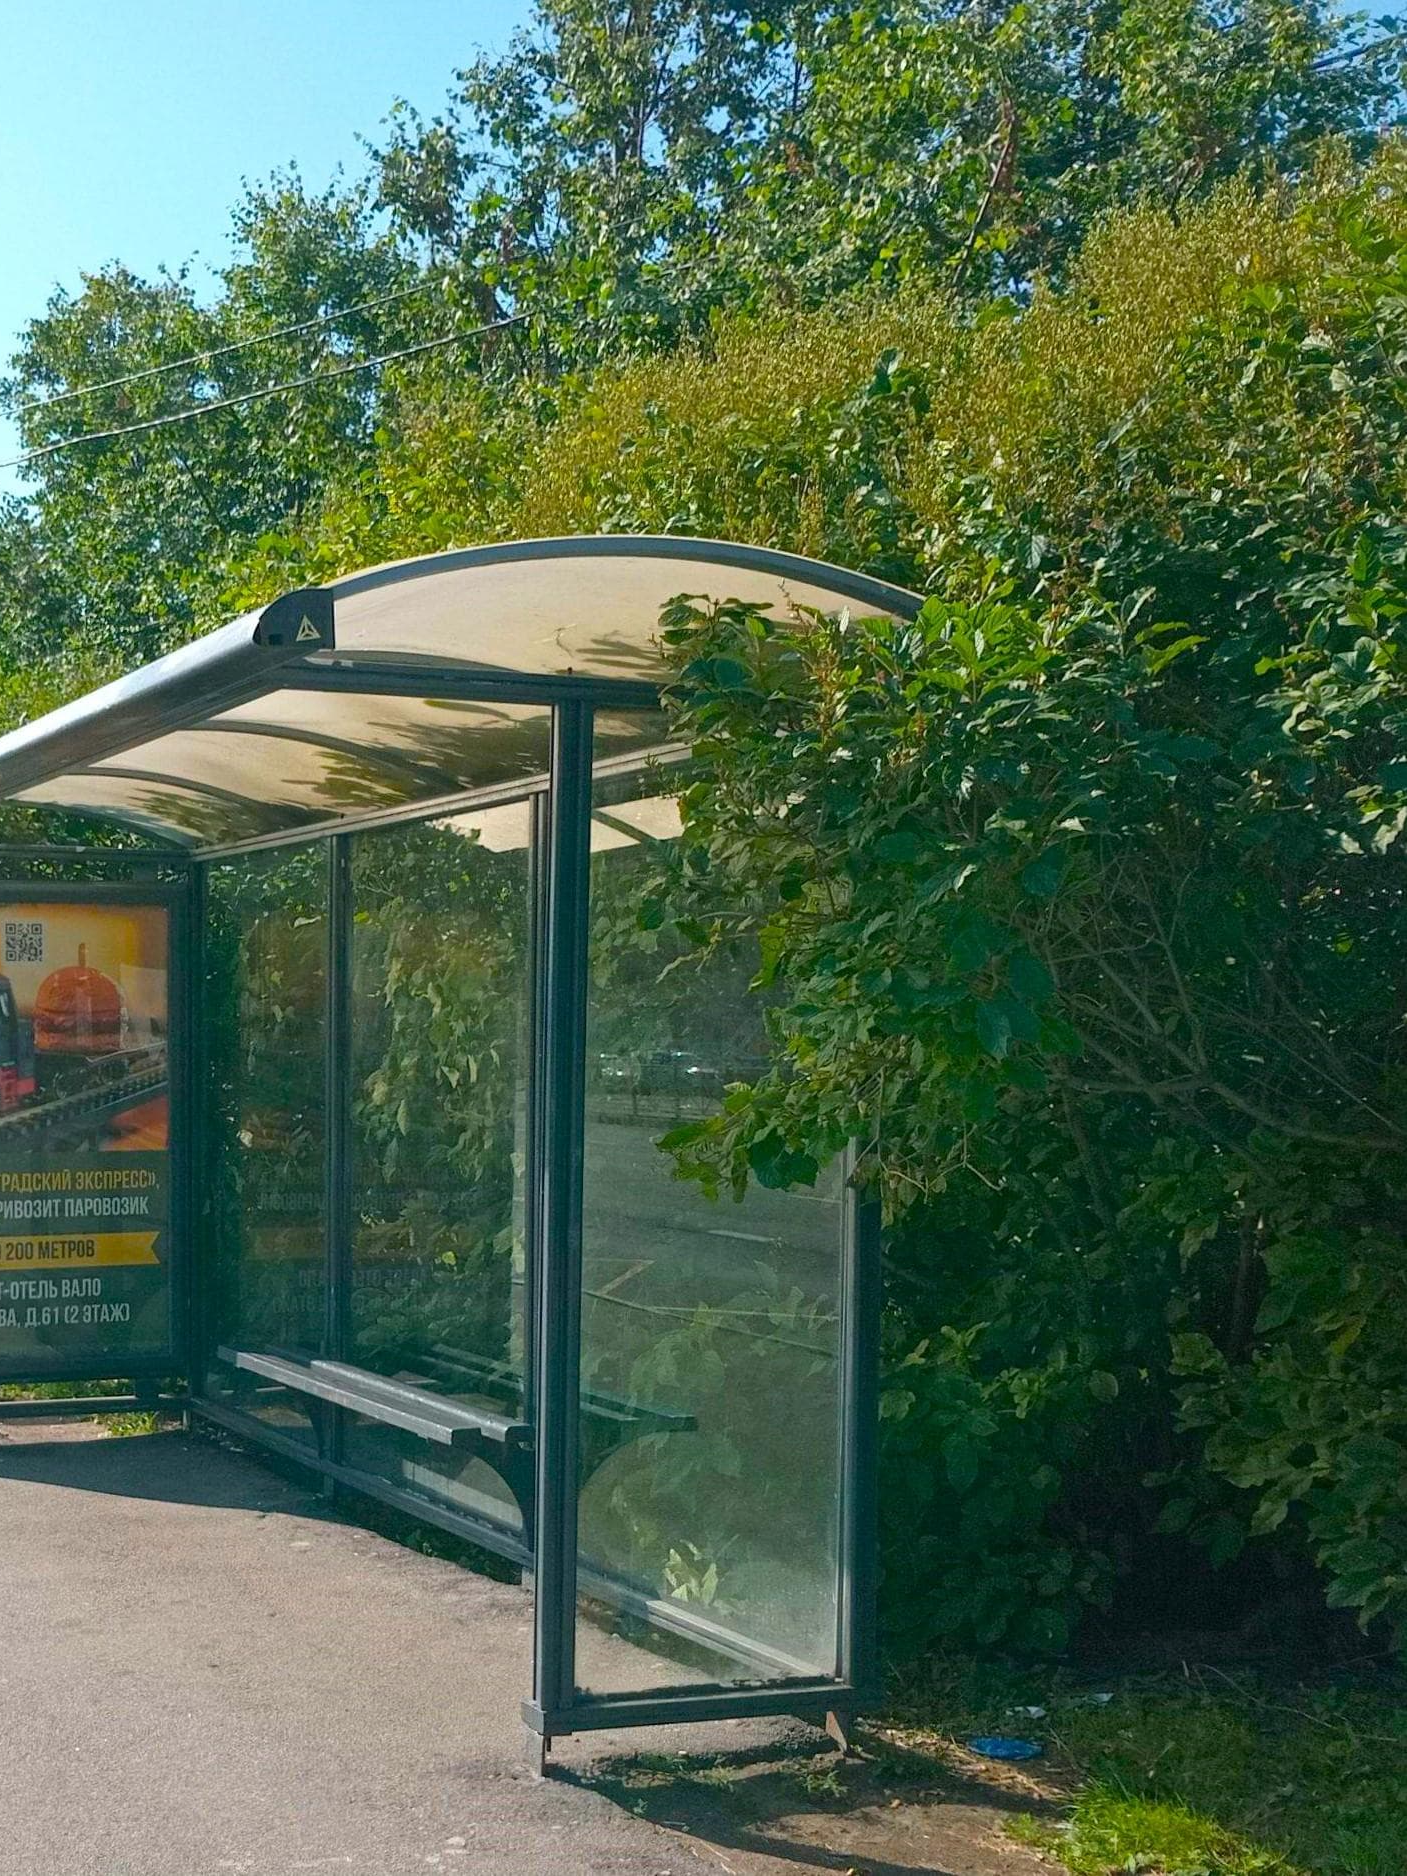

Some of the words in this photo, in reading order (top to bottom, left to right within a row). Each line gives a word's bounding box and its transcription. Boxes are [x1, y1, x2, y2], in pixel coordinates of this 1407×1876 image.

[76, 1169, 160, 1190] ЭКСПРЕСС»,
[65, 1196, 149, 1218] ПАРОВОЗИК
[6, 1242, 34, 1260] 200
[38, 1240, 95, 1259] МЕТРОВ
[61, 1278, 101, 1298] ВАЛО
[24, 1306, 59, 1328] Д.61
[64, 1305, 79, 1324] (2
[82, 1303, 130, 1323] ЭТАЖ)
